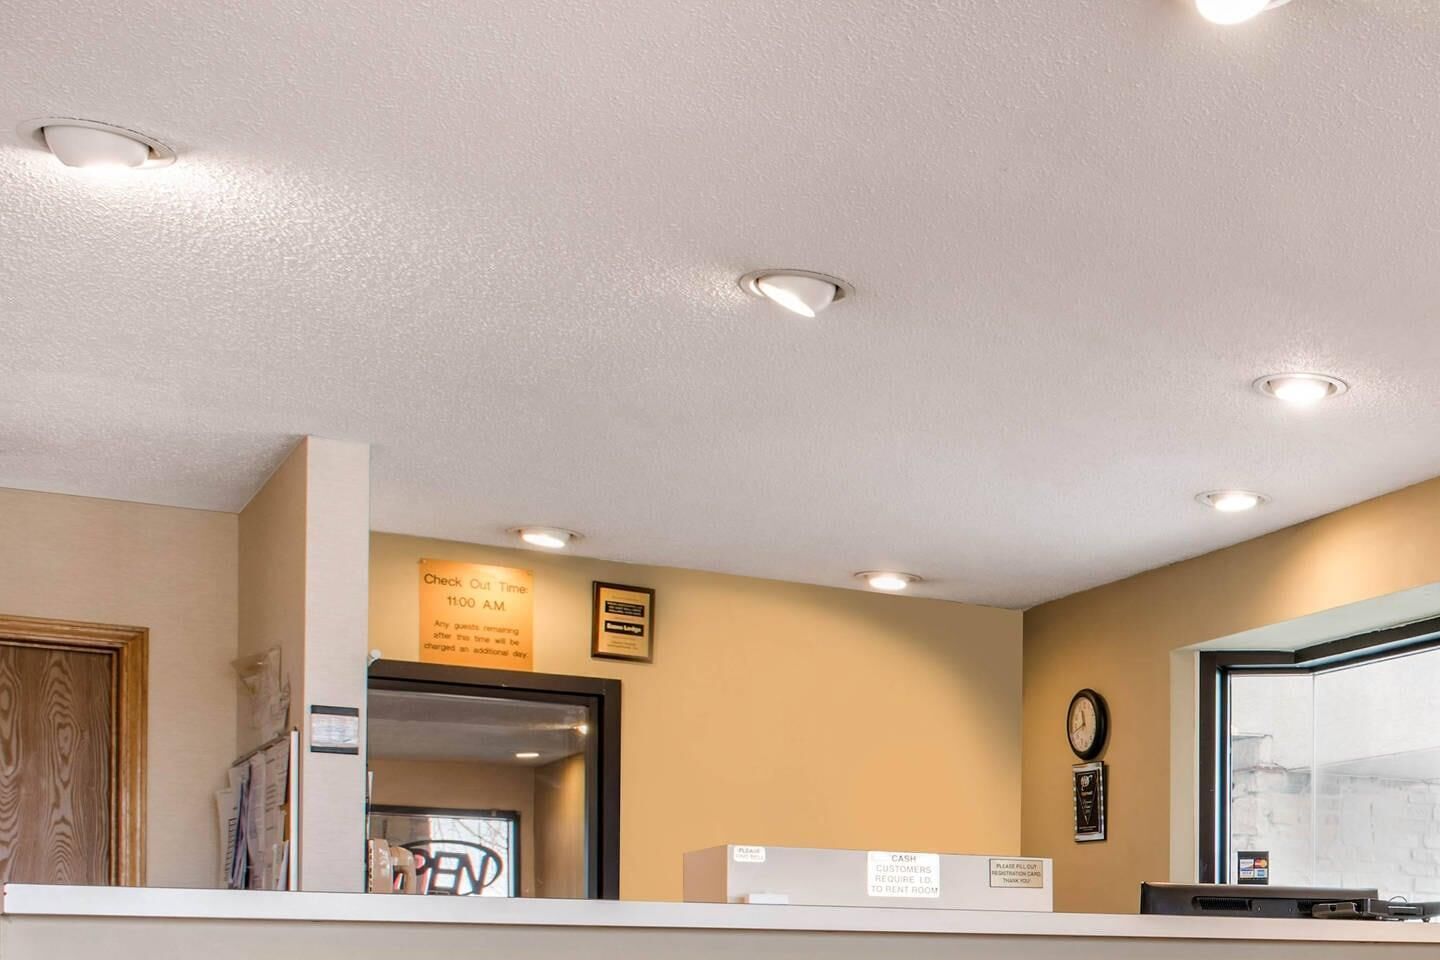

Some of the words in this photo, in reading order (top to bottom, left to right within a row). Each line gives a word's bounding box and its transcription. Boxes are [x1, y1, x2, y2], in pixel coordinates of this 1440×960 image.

[424, 573, 461, 588] Check
[470, 578, 491, 590] Out
[434, 620, 450, 629] Any
[454, 623, 480, 632] guests
[483, 626, 520, 636] remaining
[433, 632, 452, 640] after
[424, 642, 456, 652] charged
[473, 648, 509, 656] additional
[876, 864, 932, 874] CUSTOMERS
[875, 875, 915, 884] REQUIRE
[912, 886, 938, 895] ROOM
